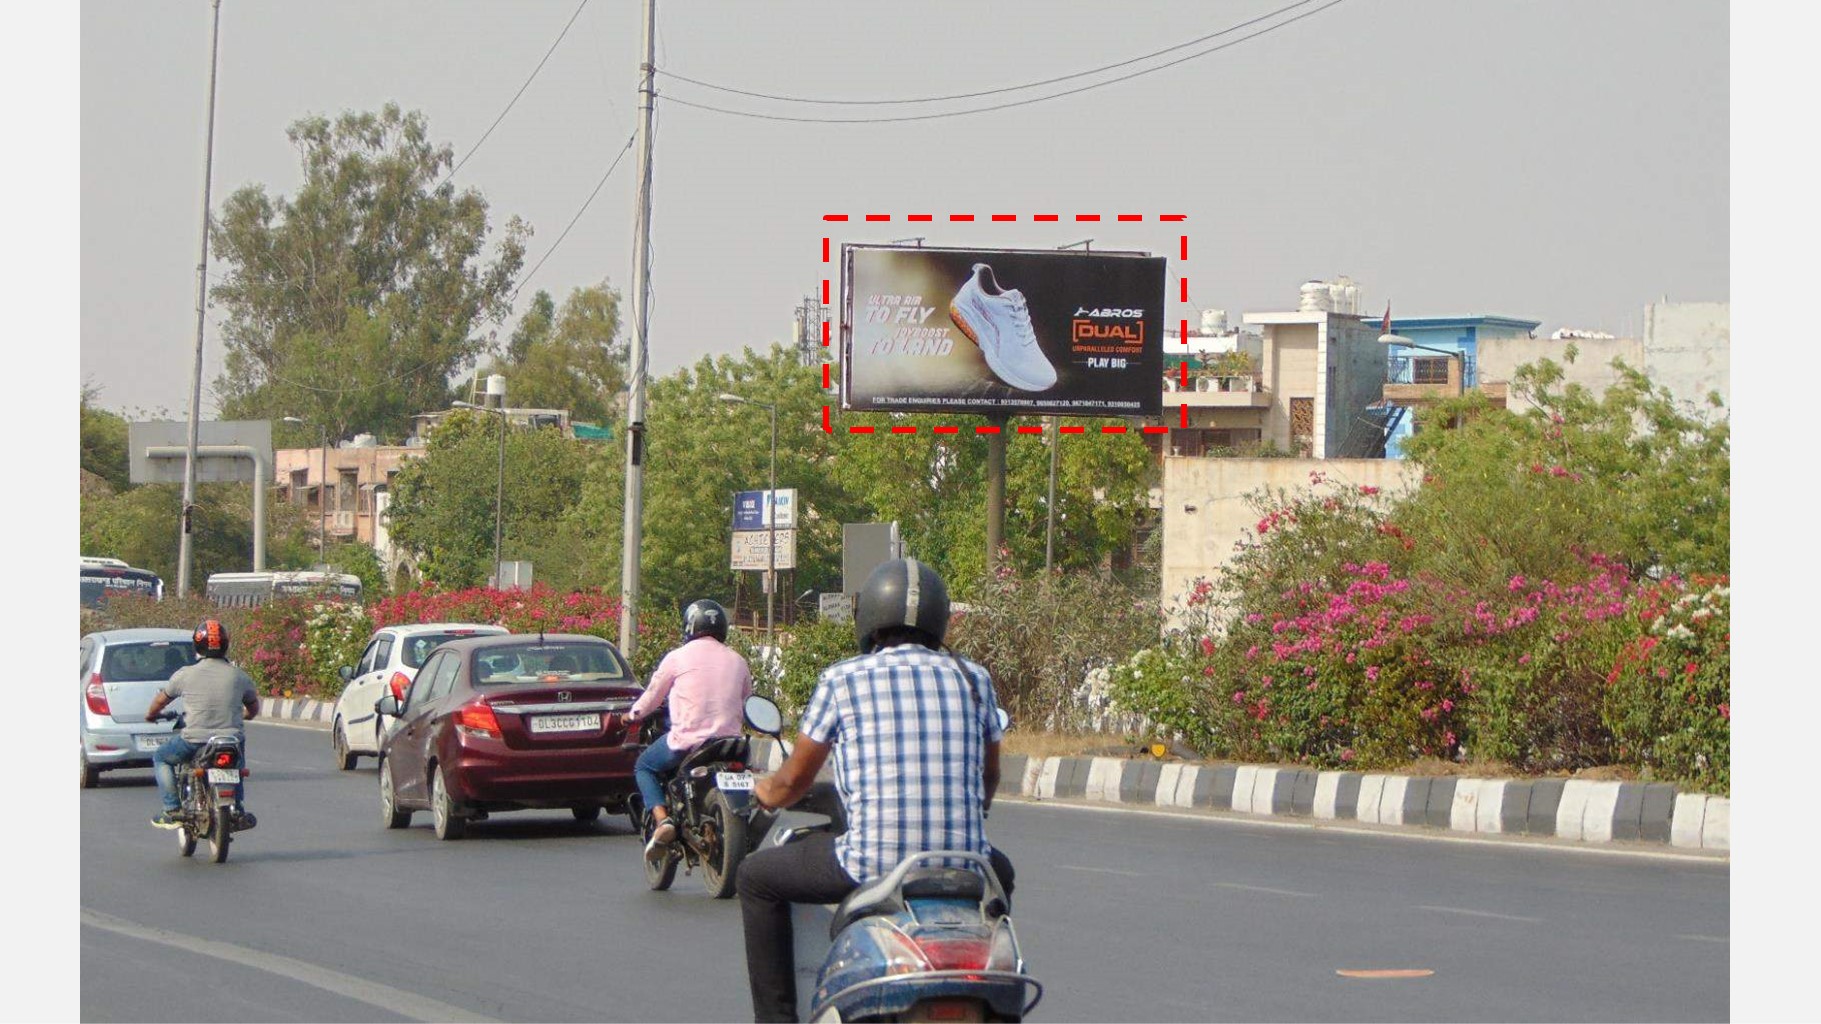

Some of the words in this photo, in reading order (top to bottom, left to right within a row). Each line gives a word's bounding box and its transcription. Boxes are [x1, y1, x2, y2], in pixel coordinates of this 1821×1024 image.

[869, 294, 902, 305] ULTRA
[903, 294, 922, 305] AIR
[866, 306, 892, 323] TO
[895, 306, 936, 324] FLY
[1088, 308, 1144, 318] ABROS
[1079, 325, 1137, 339] DUAL
[869, 338, 896, 355] TO
[899, 338, 954, 356] LAND
[1115, 346, 1143, 354] COMFORT
[1087, 357, 1110, 369] PLAY
[1110, 358, 1127, 369] BIG
[872, 396, 886, 404] FOR
[908, 397, 941, 405] ENQUIRIES
[942, 397, 966, 405] PLEASE
[967, 398, 995, 406] CONTACT
